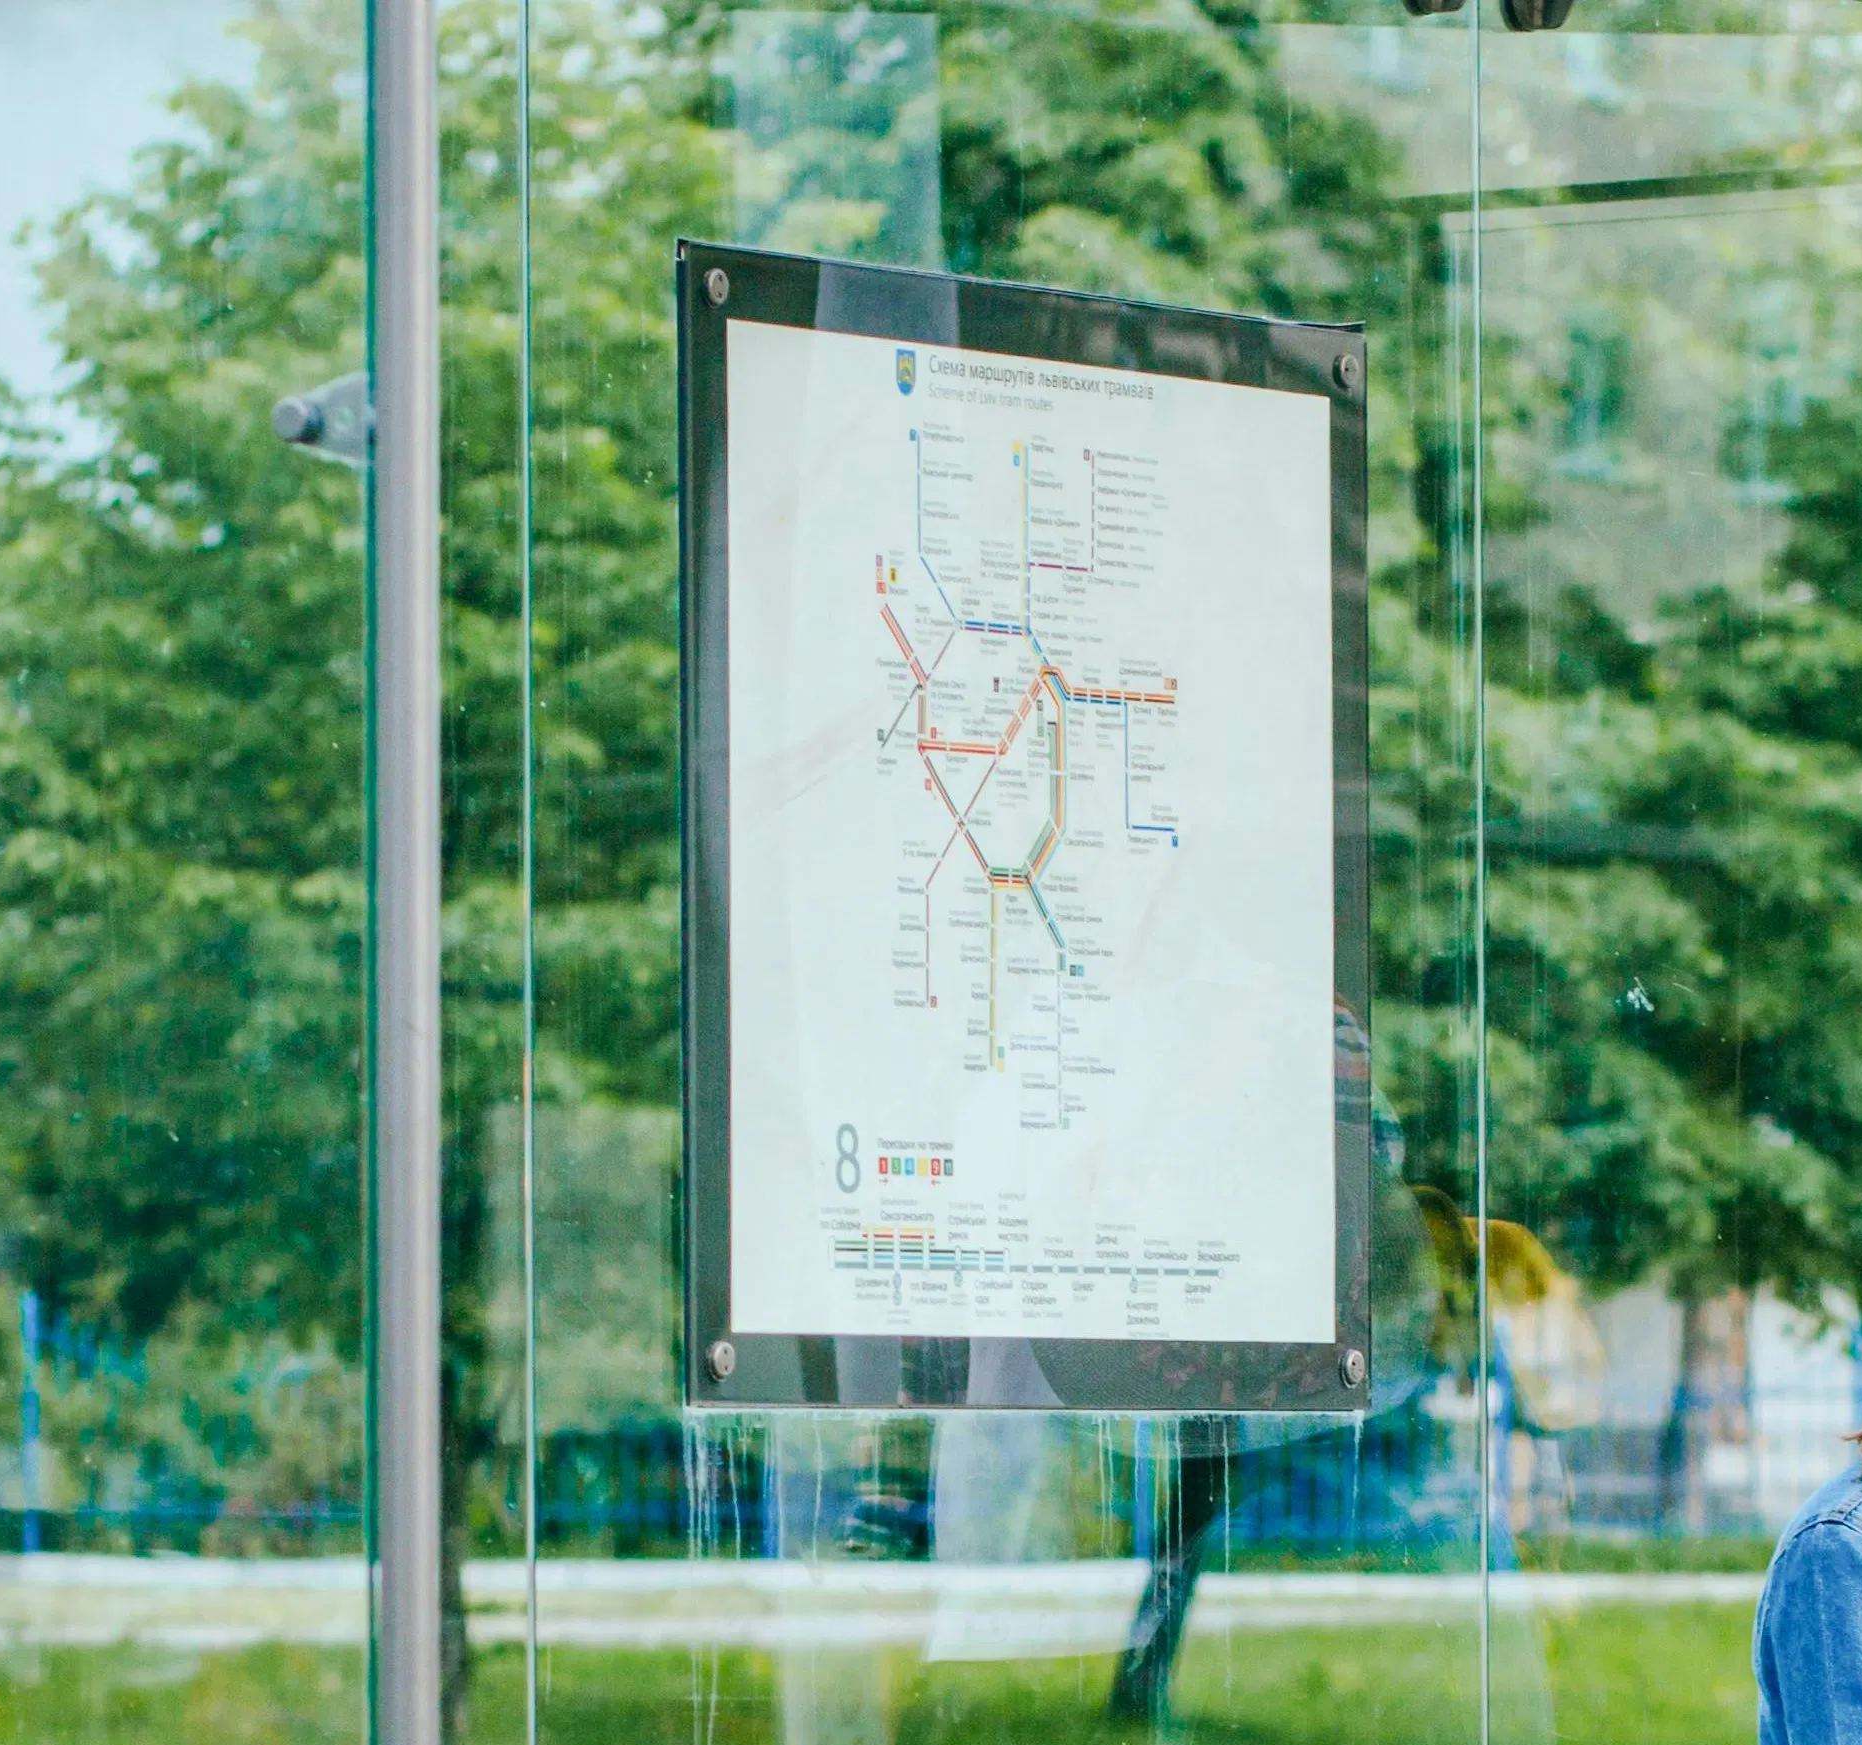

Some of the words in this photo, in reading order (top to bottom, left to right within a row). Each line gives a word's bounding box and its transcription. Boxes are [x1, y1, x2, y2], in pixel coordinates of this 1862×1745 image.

[928, 354, 966, 378] Схема
[968, 366, 1035, 389] маршрутів
[1037, 371, 1101, 391] львівських
[1103, 380, 1154, 400] трамваїв
[928, 383, 965, 402] Scheme
[967, 387, 978, 403] of
[979, 390, 997, 405] Lviv
[998, 394, 1021, 408] tram
[1024, 397, 1054, 412] routes
[836, 1123, 860, 1193] 8
